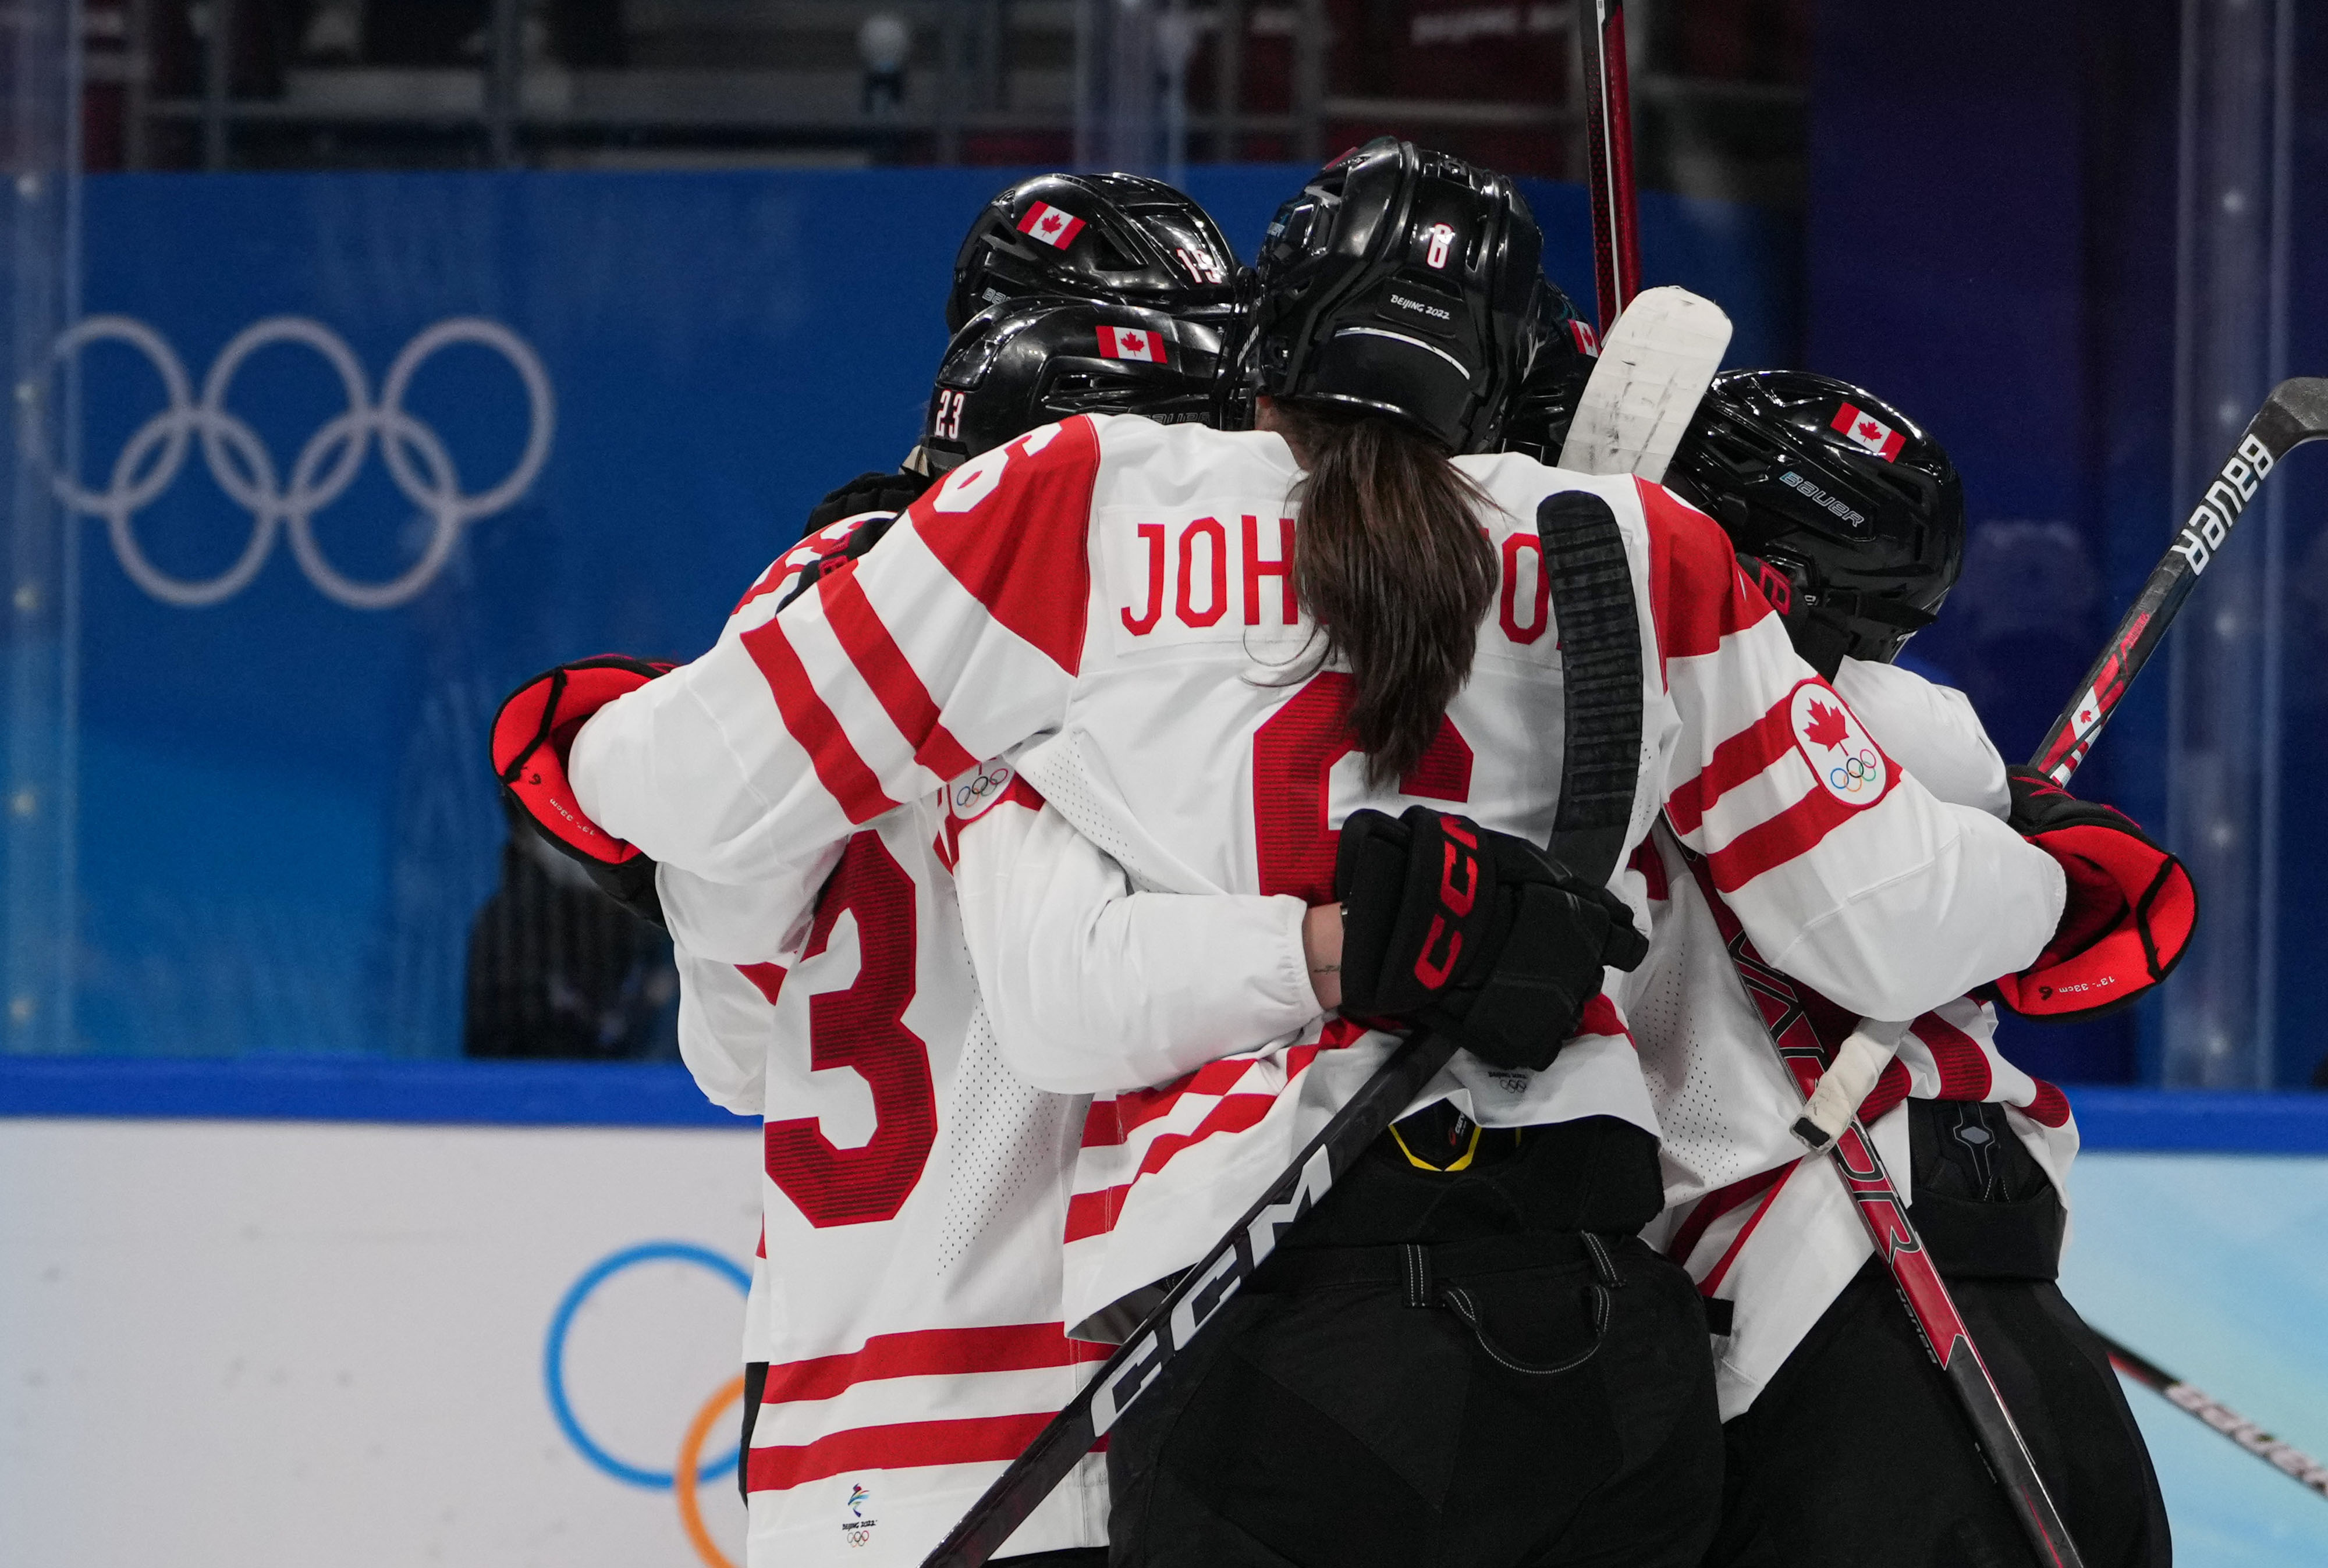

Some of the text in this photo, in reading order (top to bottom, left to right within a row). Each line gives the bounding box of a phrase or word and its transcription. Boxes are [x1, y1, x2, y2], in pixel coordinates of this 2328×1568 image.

[1176, 248, 1222, 284] 19
[1390, 294, 1450, 320] BEIJING 2022
[934, 389, 966, 440] 23
[1780, 471, 1864, 528] BAUER
[2171, 433, 2274, 576] BAUER
[2059, 982, 2089, 994] 33cm
[1091, 1143, 1333, 1438] CCM
